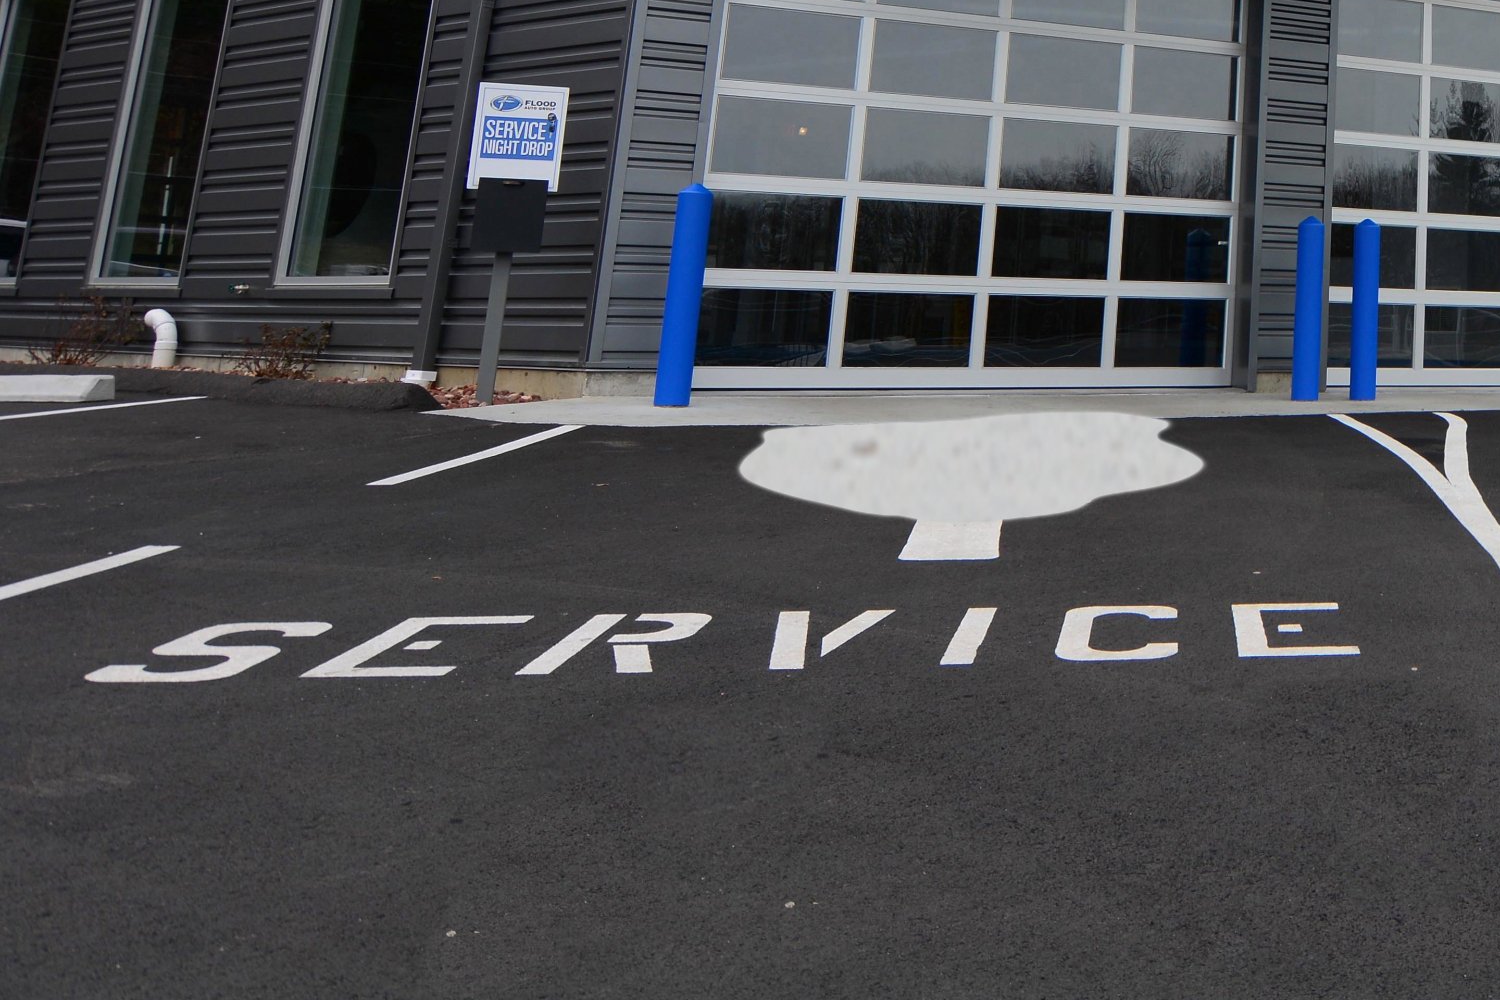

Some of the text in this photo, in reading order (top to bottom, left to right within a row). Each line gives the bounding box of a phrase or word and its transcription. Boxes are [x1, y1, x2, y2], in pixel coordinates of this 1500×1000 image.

[485, 119, 547, 140] SERVICE
[483, 139, 553, 157] NIGHT DROP
[85, 602, 1360, 682] SERVICE
